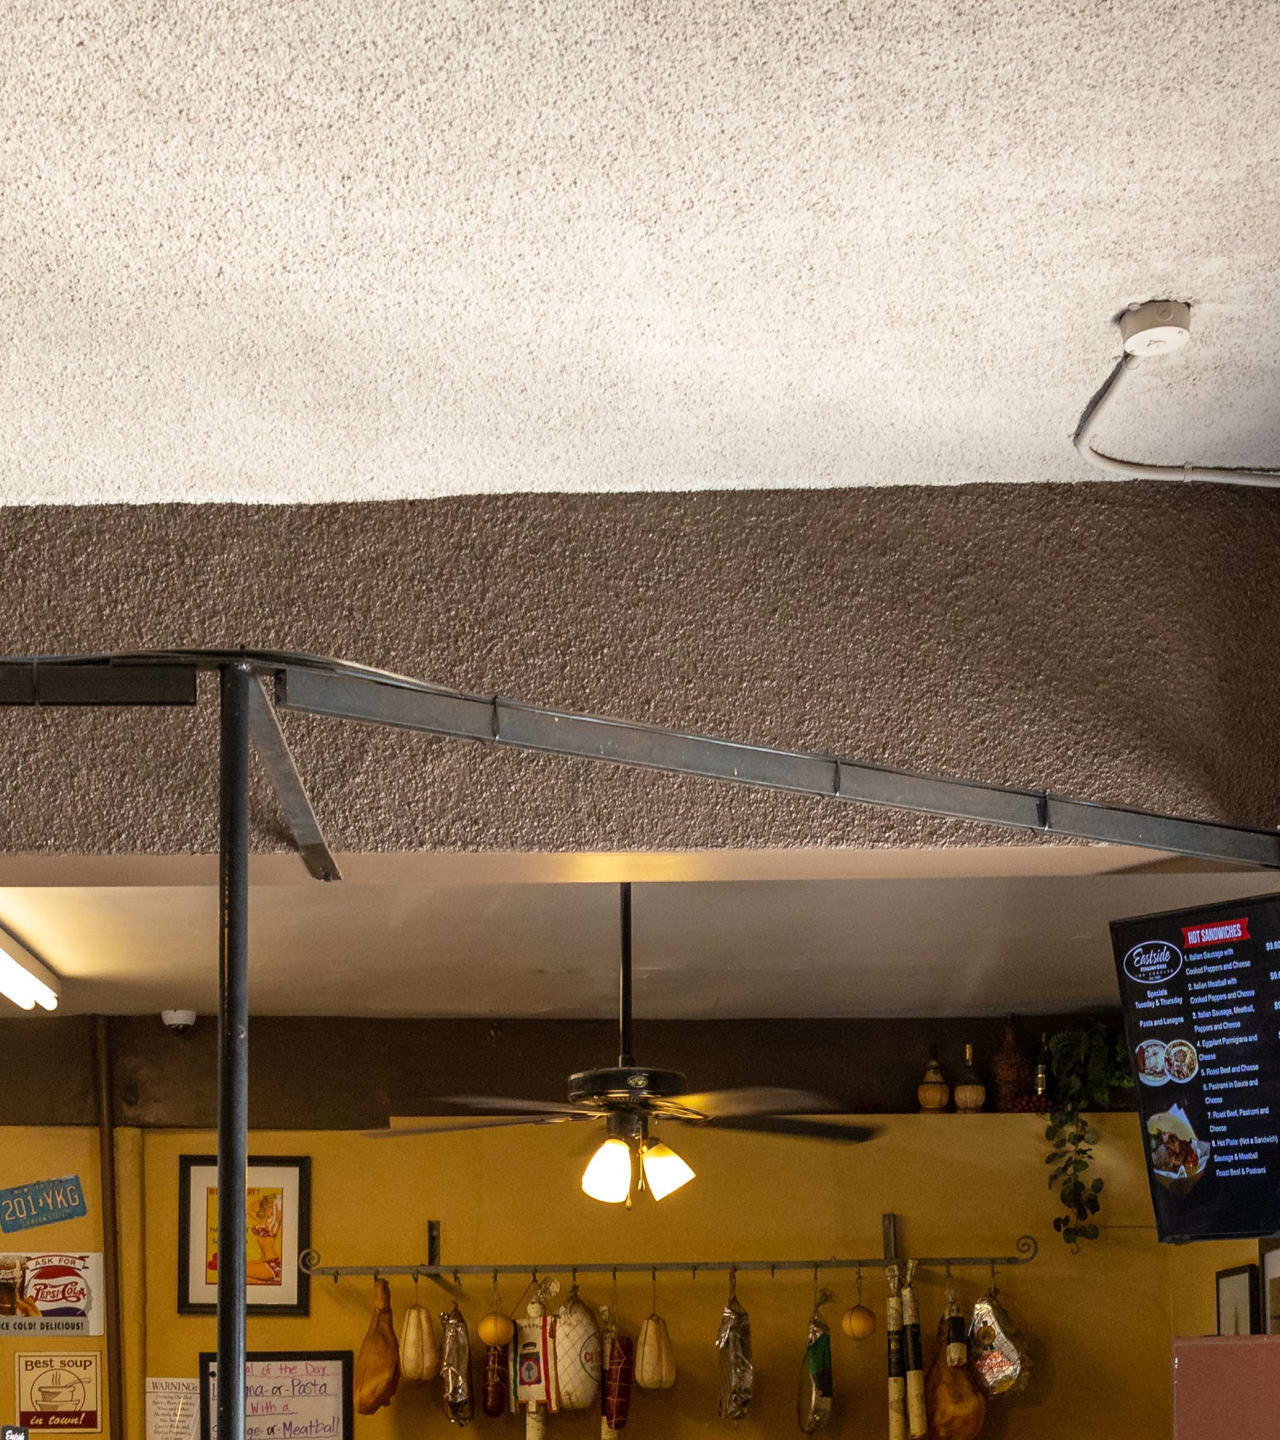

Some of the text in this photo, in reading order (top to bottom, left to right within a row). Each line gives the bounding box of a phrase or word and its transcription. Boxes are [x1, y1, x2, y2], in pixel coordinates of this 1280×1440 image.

[1188, 924, 1241, 944] HOT SANDWICHES
[1133, 946, 1171, 968] Eastside
[1147, 989, 1168, 998] Specials
[34, 1257, 76, 1267] ASK FOR
[13, 1322, 36, 1330] COLD!
[40, 1322, 84, 1330] DELICIOUS!
[24, 1358, 93, 1371] Best soup
[261, 1364, 271, 1375] of
[280, 1363, 295, 1374] the
[306, 1363, 327, 1375] Day
[152, 1382, 198, 1392] WARNING:
[291, 1379, 328, 1395] Pasta
[250, 1402, 276, 1414] With
[30, 1412, 85, 1425] in town!
[283, 1416, 339, 1438] Meatball
